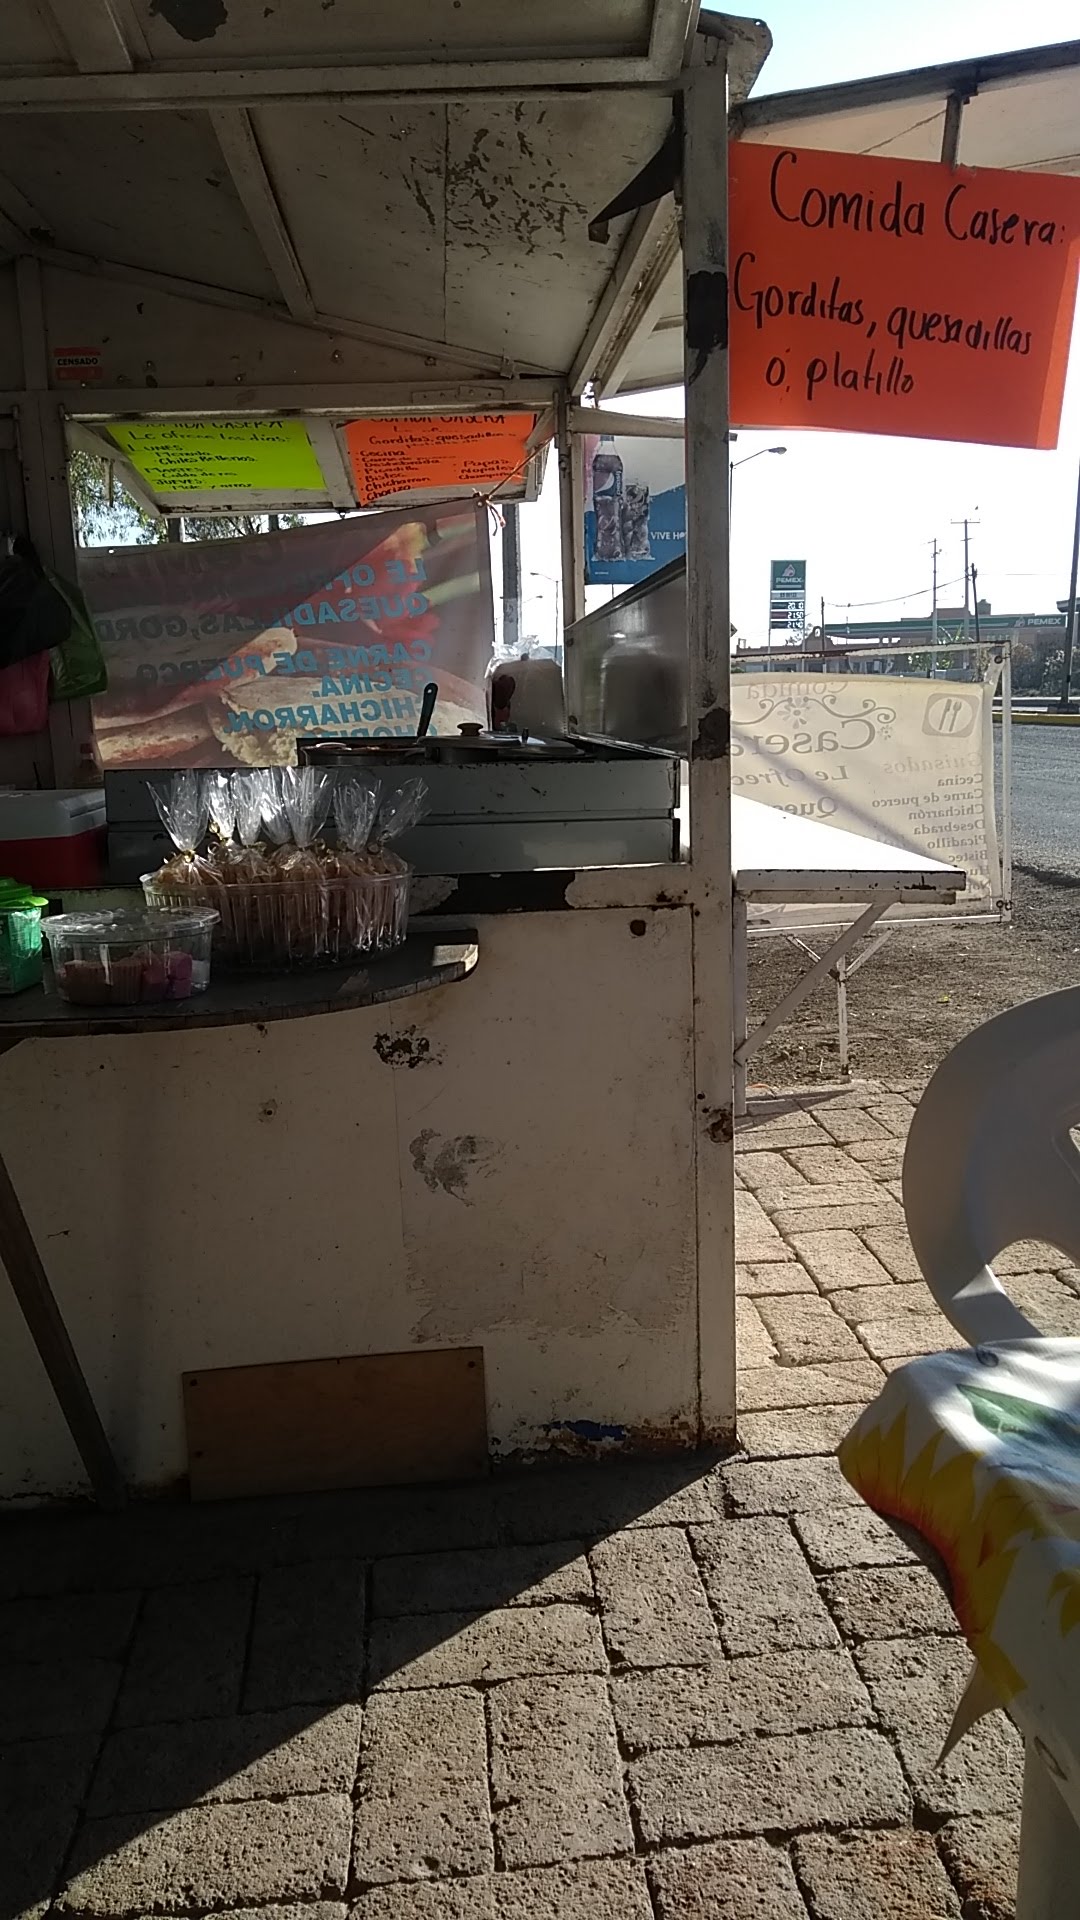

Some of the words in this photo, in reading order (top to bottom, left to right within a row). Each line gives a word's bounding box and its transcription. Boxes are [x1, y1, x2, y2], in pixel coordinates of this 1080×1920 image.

[770, 150, 925, 237] Comida
[944, 184, 1066, 246] Casera:
[733, 252, 877, 338] Gorditas,
[886, 306, 1032, 355] quesadillas
[57, 357, 98, 366] CENSADO
[806, 348, 915, 401] platillo
[650, 531, 671, 540] VIVE
[1027, 617, 1062, 626] PEMEX
